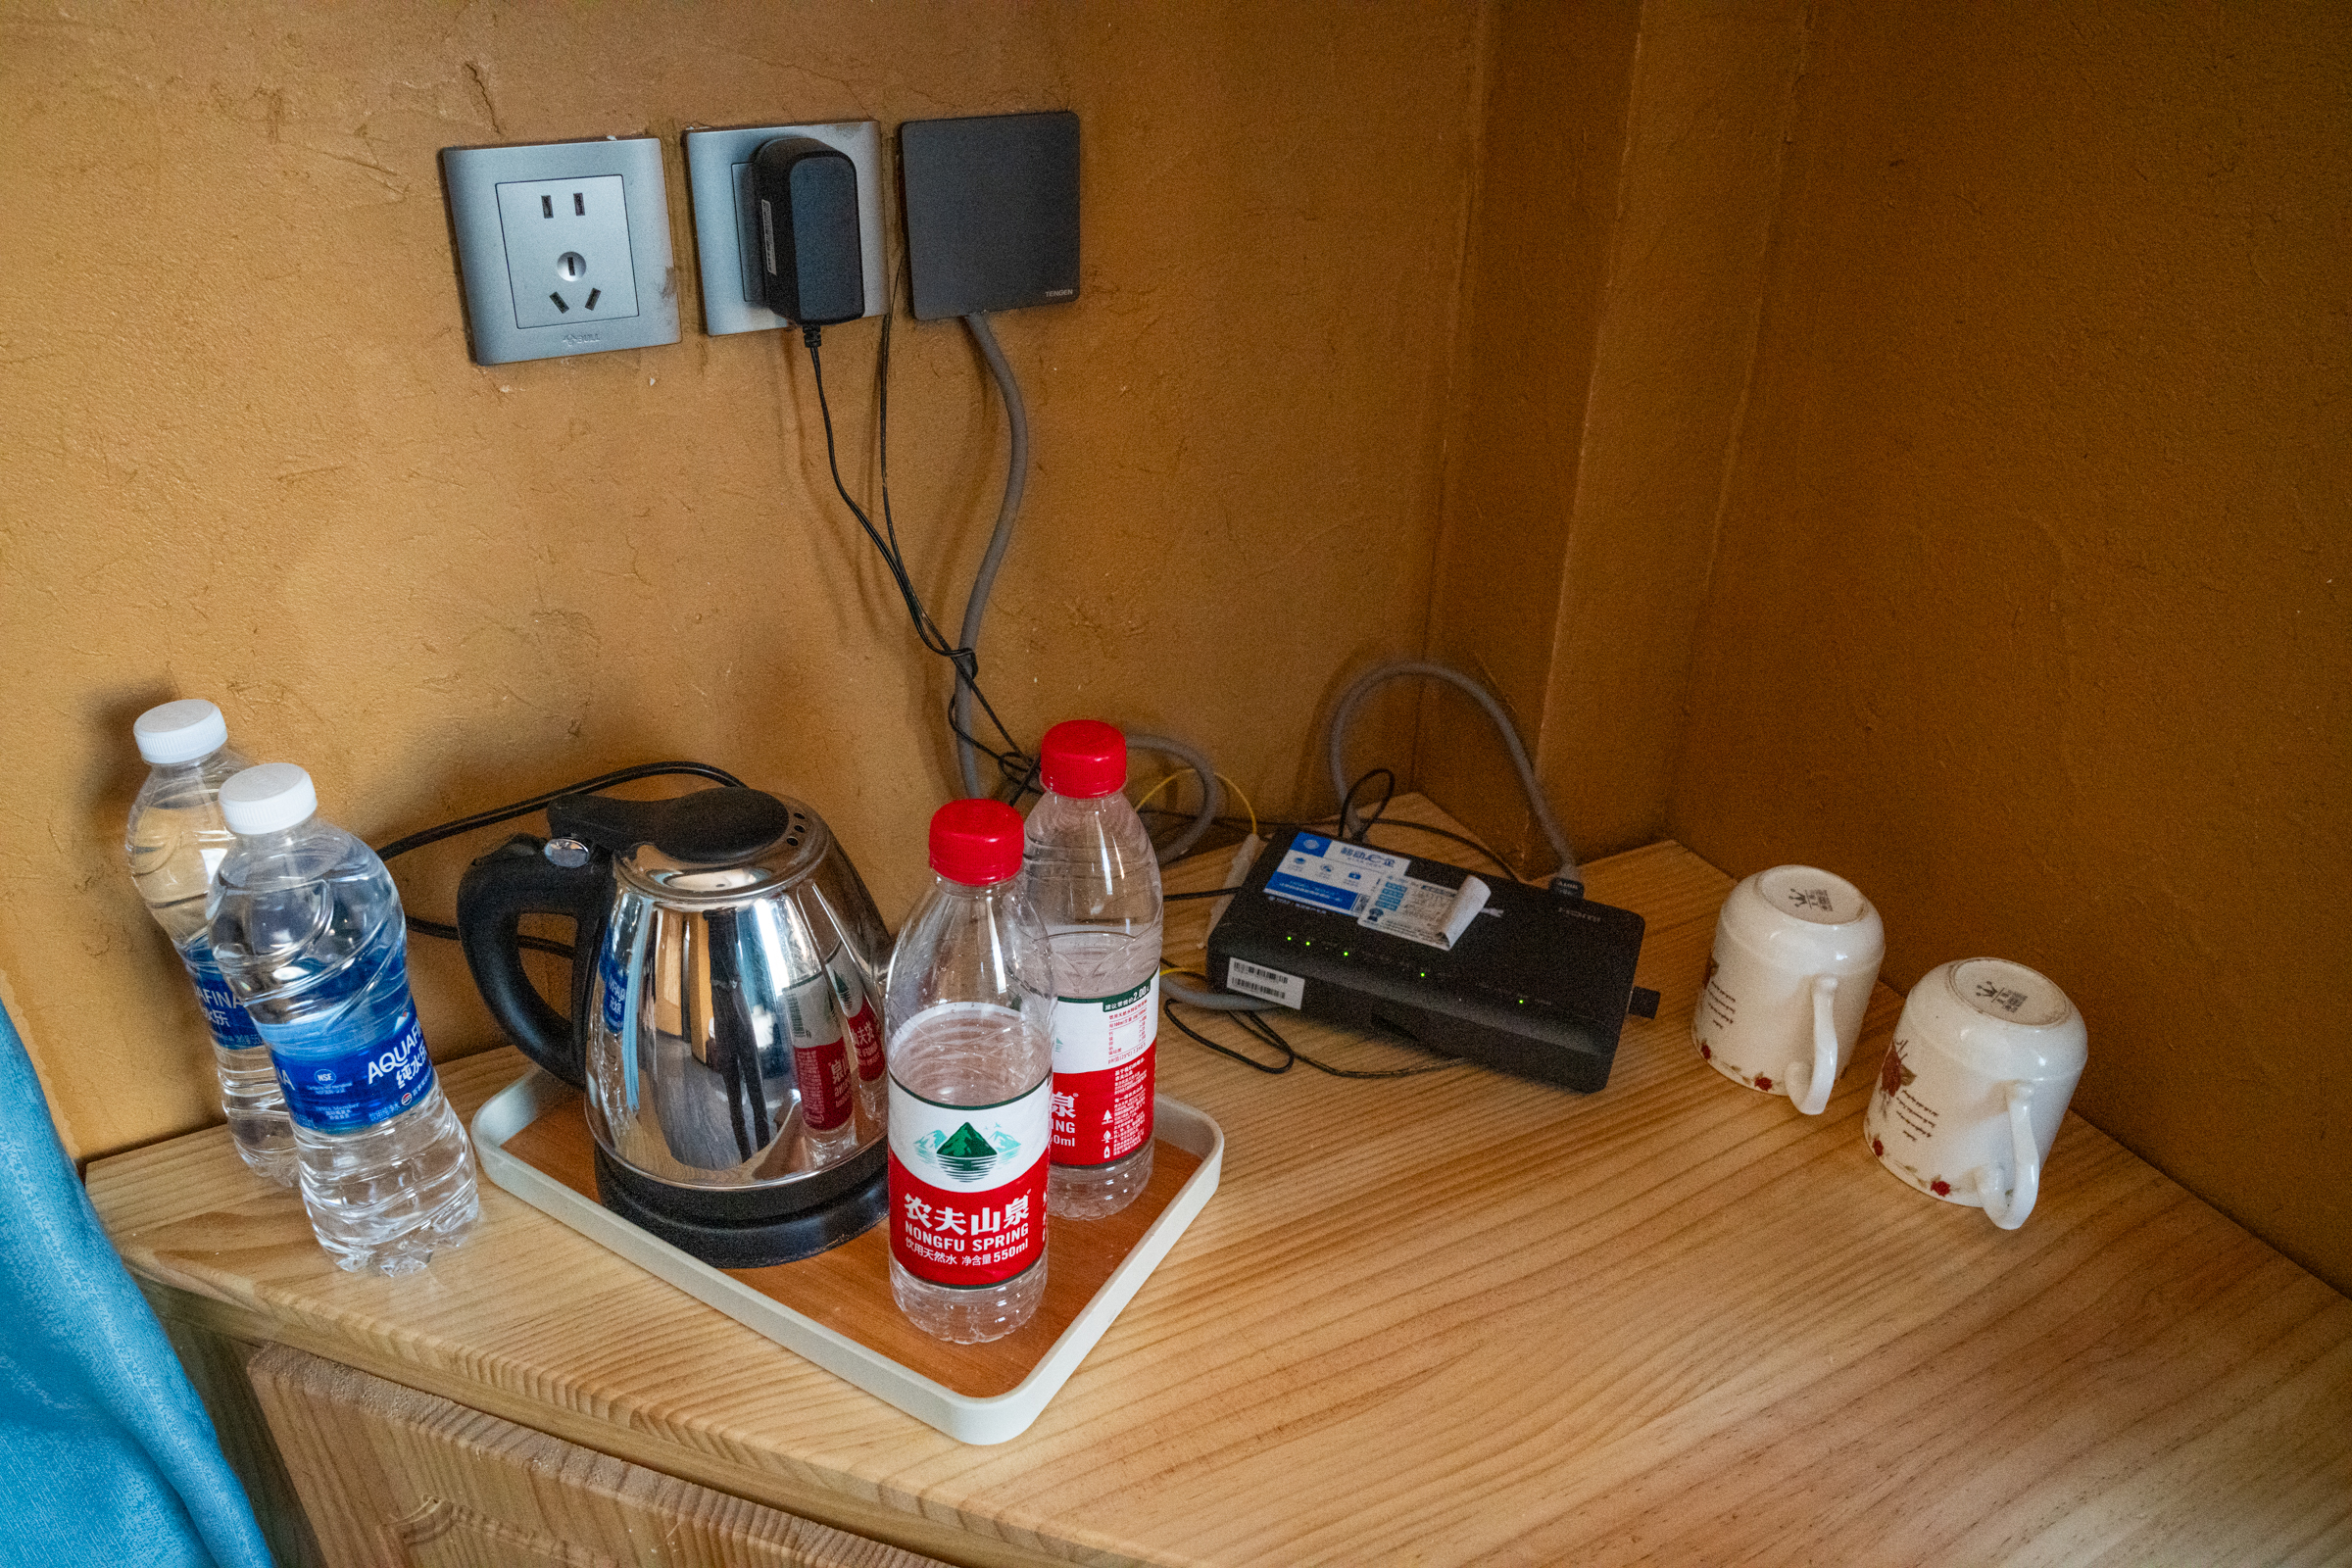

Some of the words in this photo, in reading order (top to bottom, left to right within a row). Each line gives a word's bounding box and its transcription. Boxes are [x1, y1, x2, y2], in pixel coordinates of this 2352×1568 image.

[904, 1193, 1029, 1236] 农夫山泉
[905, 1220, 965, 1252] NONGFU
[972, 1222, 1029, 1252] SPRING
[905, 1237, 957, 1265] 饮用天然水
